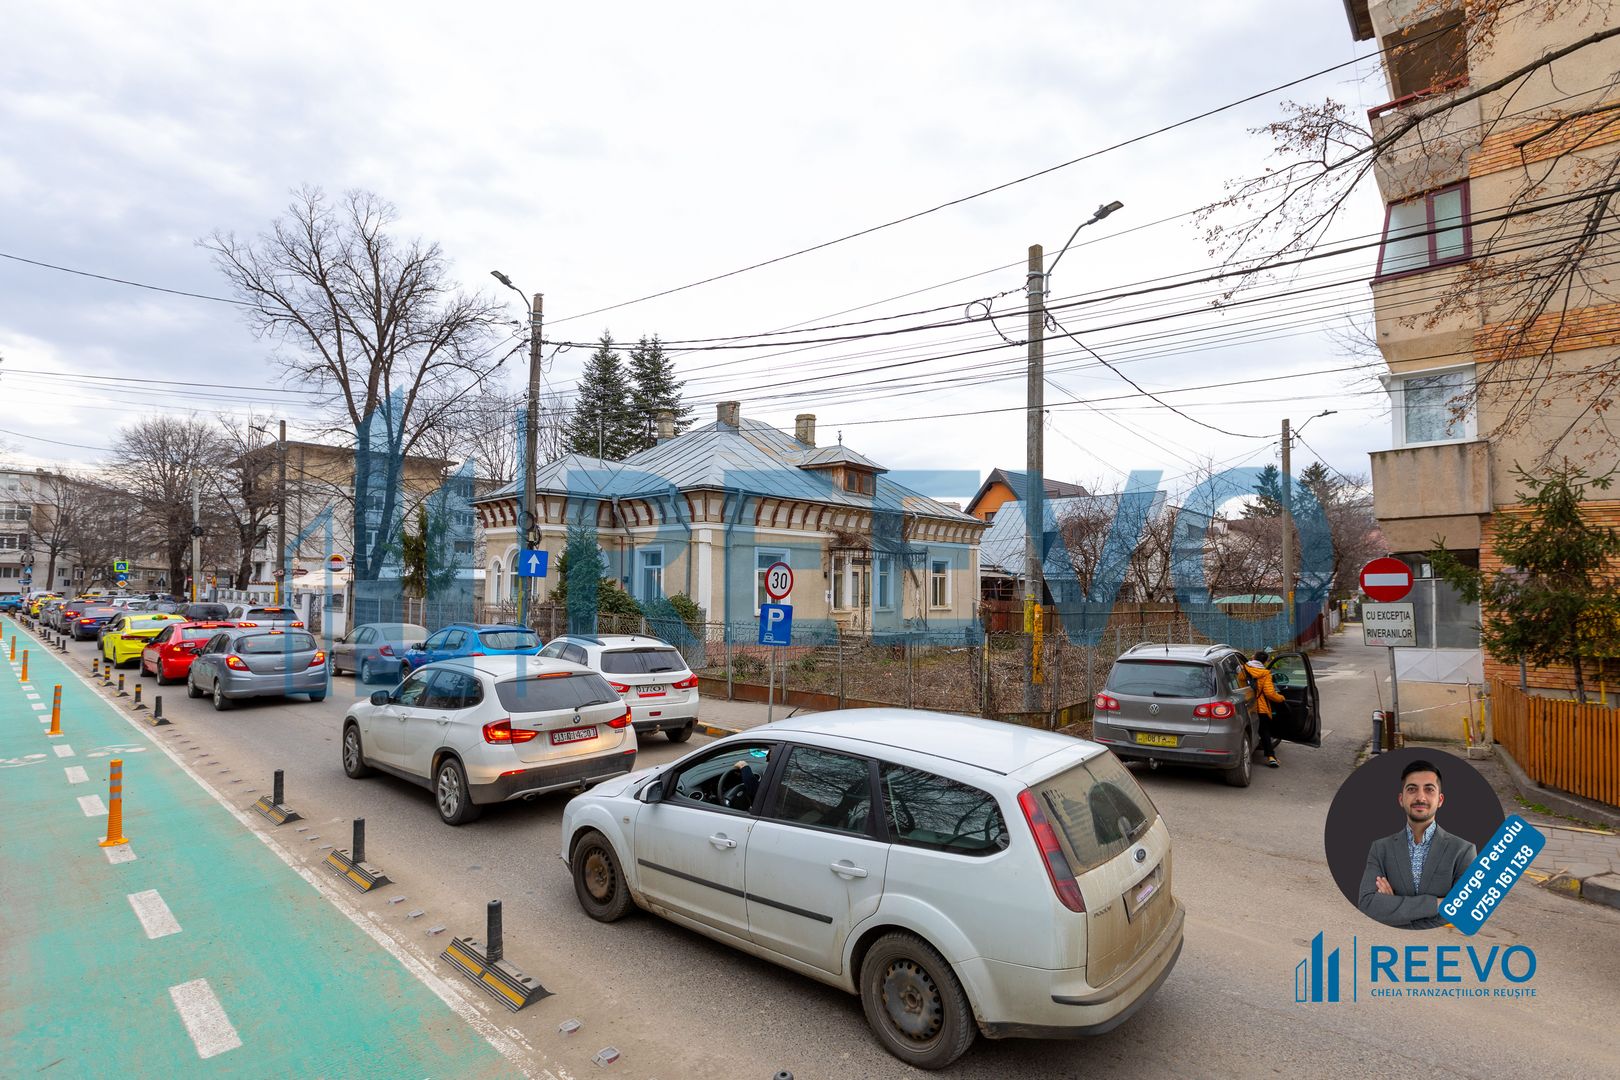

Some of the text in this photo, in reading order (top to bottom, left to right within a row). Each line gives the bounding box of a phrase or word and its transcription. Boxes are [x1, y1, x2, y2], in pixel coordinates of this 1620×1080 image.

[772, 572, 787, 589] 30
[767, 608, 785, 631] P
[1366, 611, 1376, 620] CU
[1367, 629, 1412, 638] RIVERANILOR
